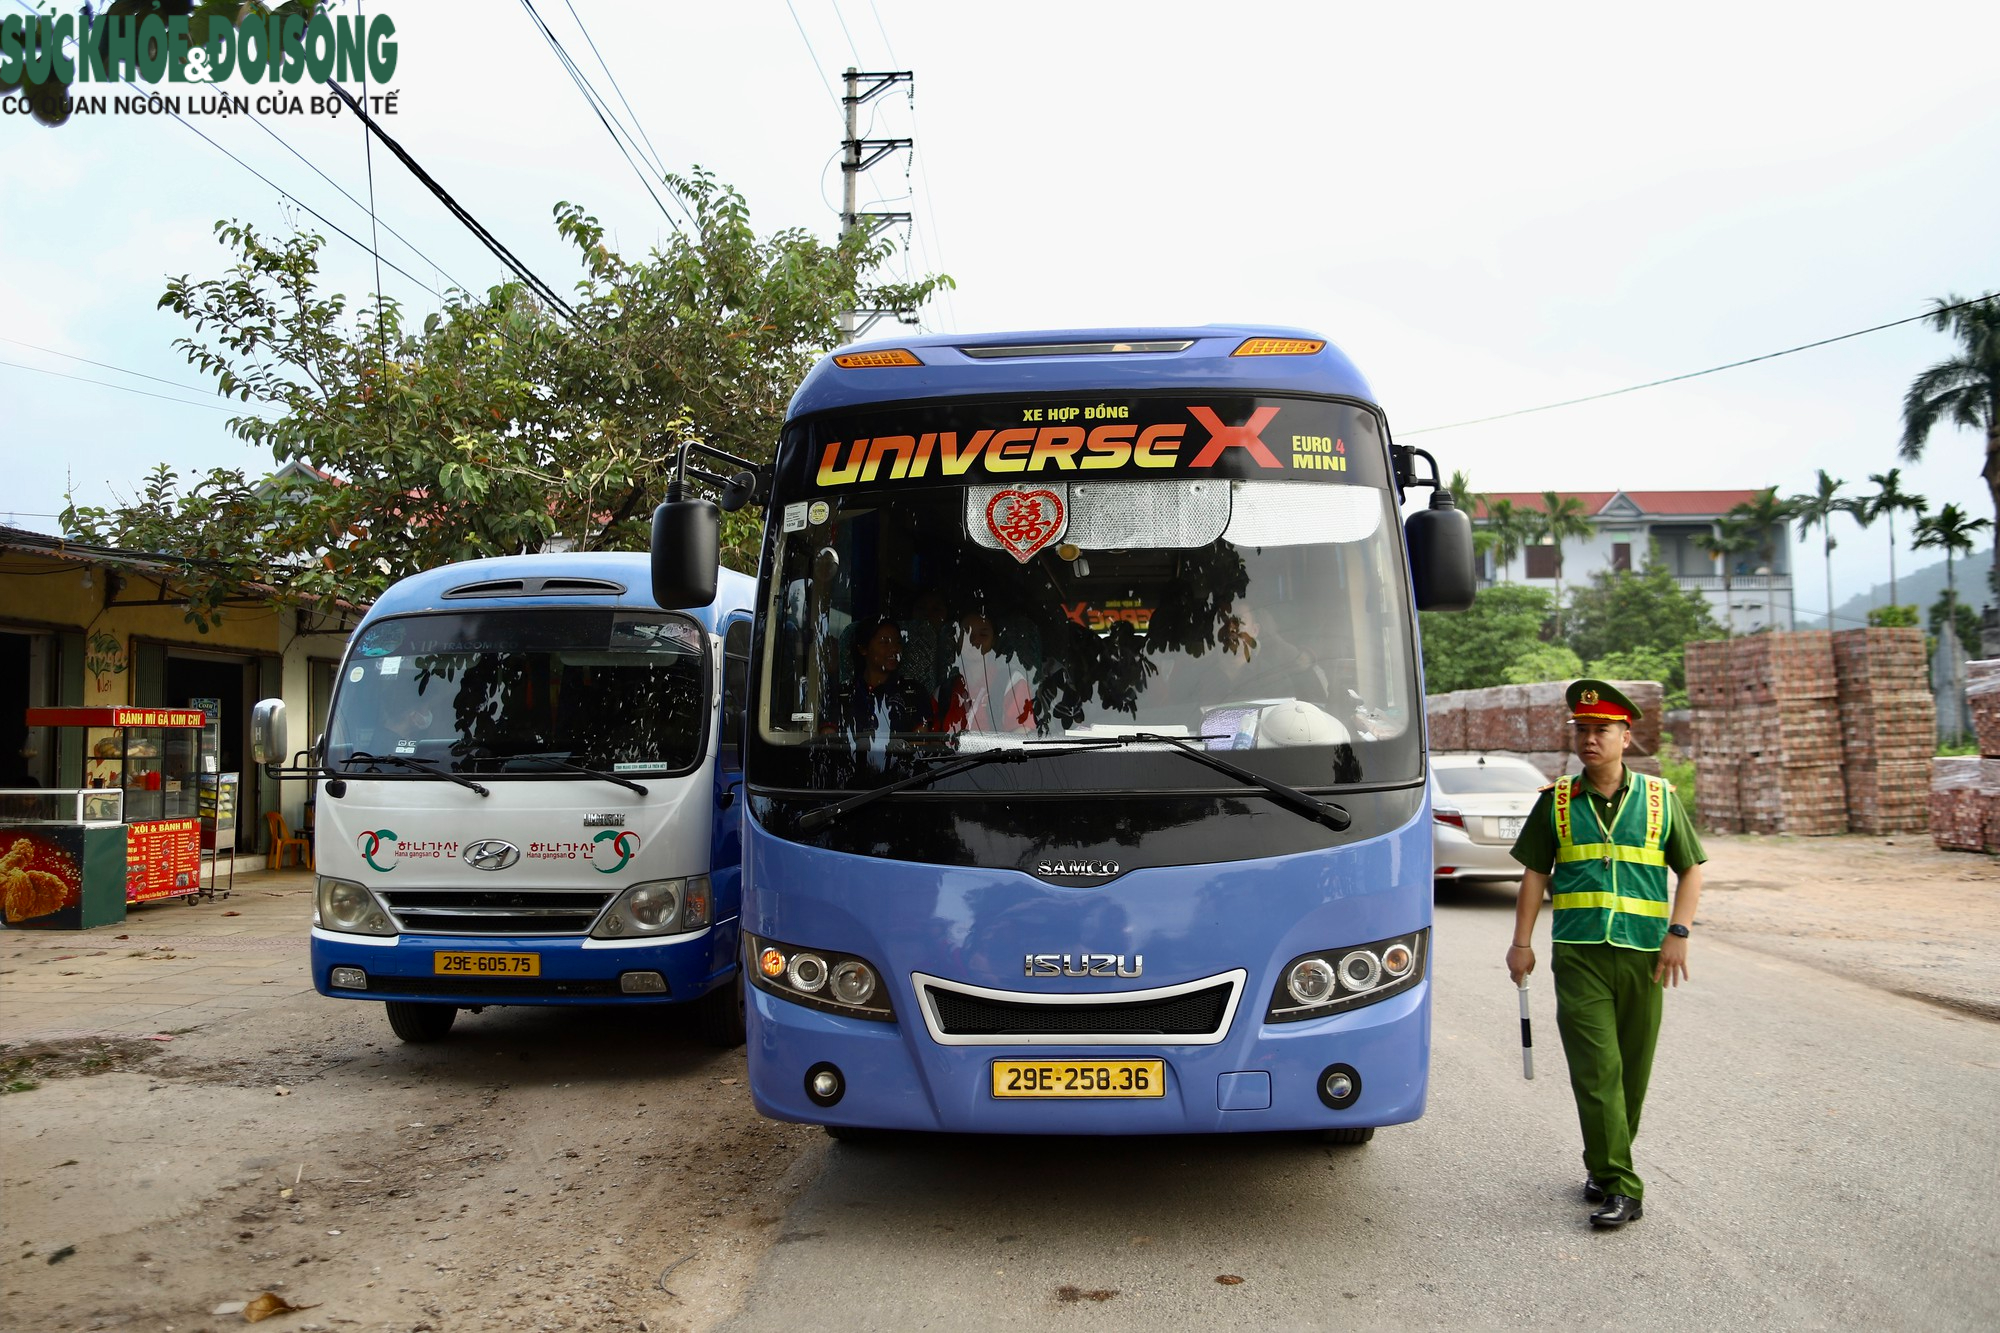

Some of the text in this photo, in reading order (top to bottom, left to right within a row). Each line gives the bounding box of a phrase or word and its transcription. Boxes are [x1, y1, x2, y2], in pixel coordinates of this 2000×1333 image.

[1022, 404, 1129, 423] XE HỢP ĐỒNG
[816, 406, 1285, 487] UNIVERSE X
[1292, 435, 1345, 454] EURO 4
[1292, 454, 1347, 472] MINI
[119, 710, 201, 725] BÁNH MÌ GÀ KIM CHI
[134, 820, 193, 834] XÔI & BÁNH MÌ
[397, 841, 459, 858] 하나강산
[530, 842, 596, 859] 하나강산
[1037, 859, 1120, 876] SAMCO
[443, 955, 531, 972] 29E-605.75
[1024, 953, 1144, 978] ISUZU
[1007, 1067, 1149, 1091] 29E-258.36
